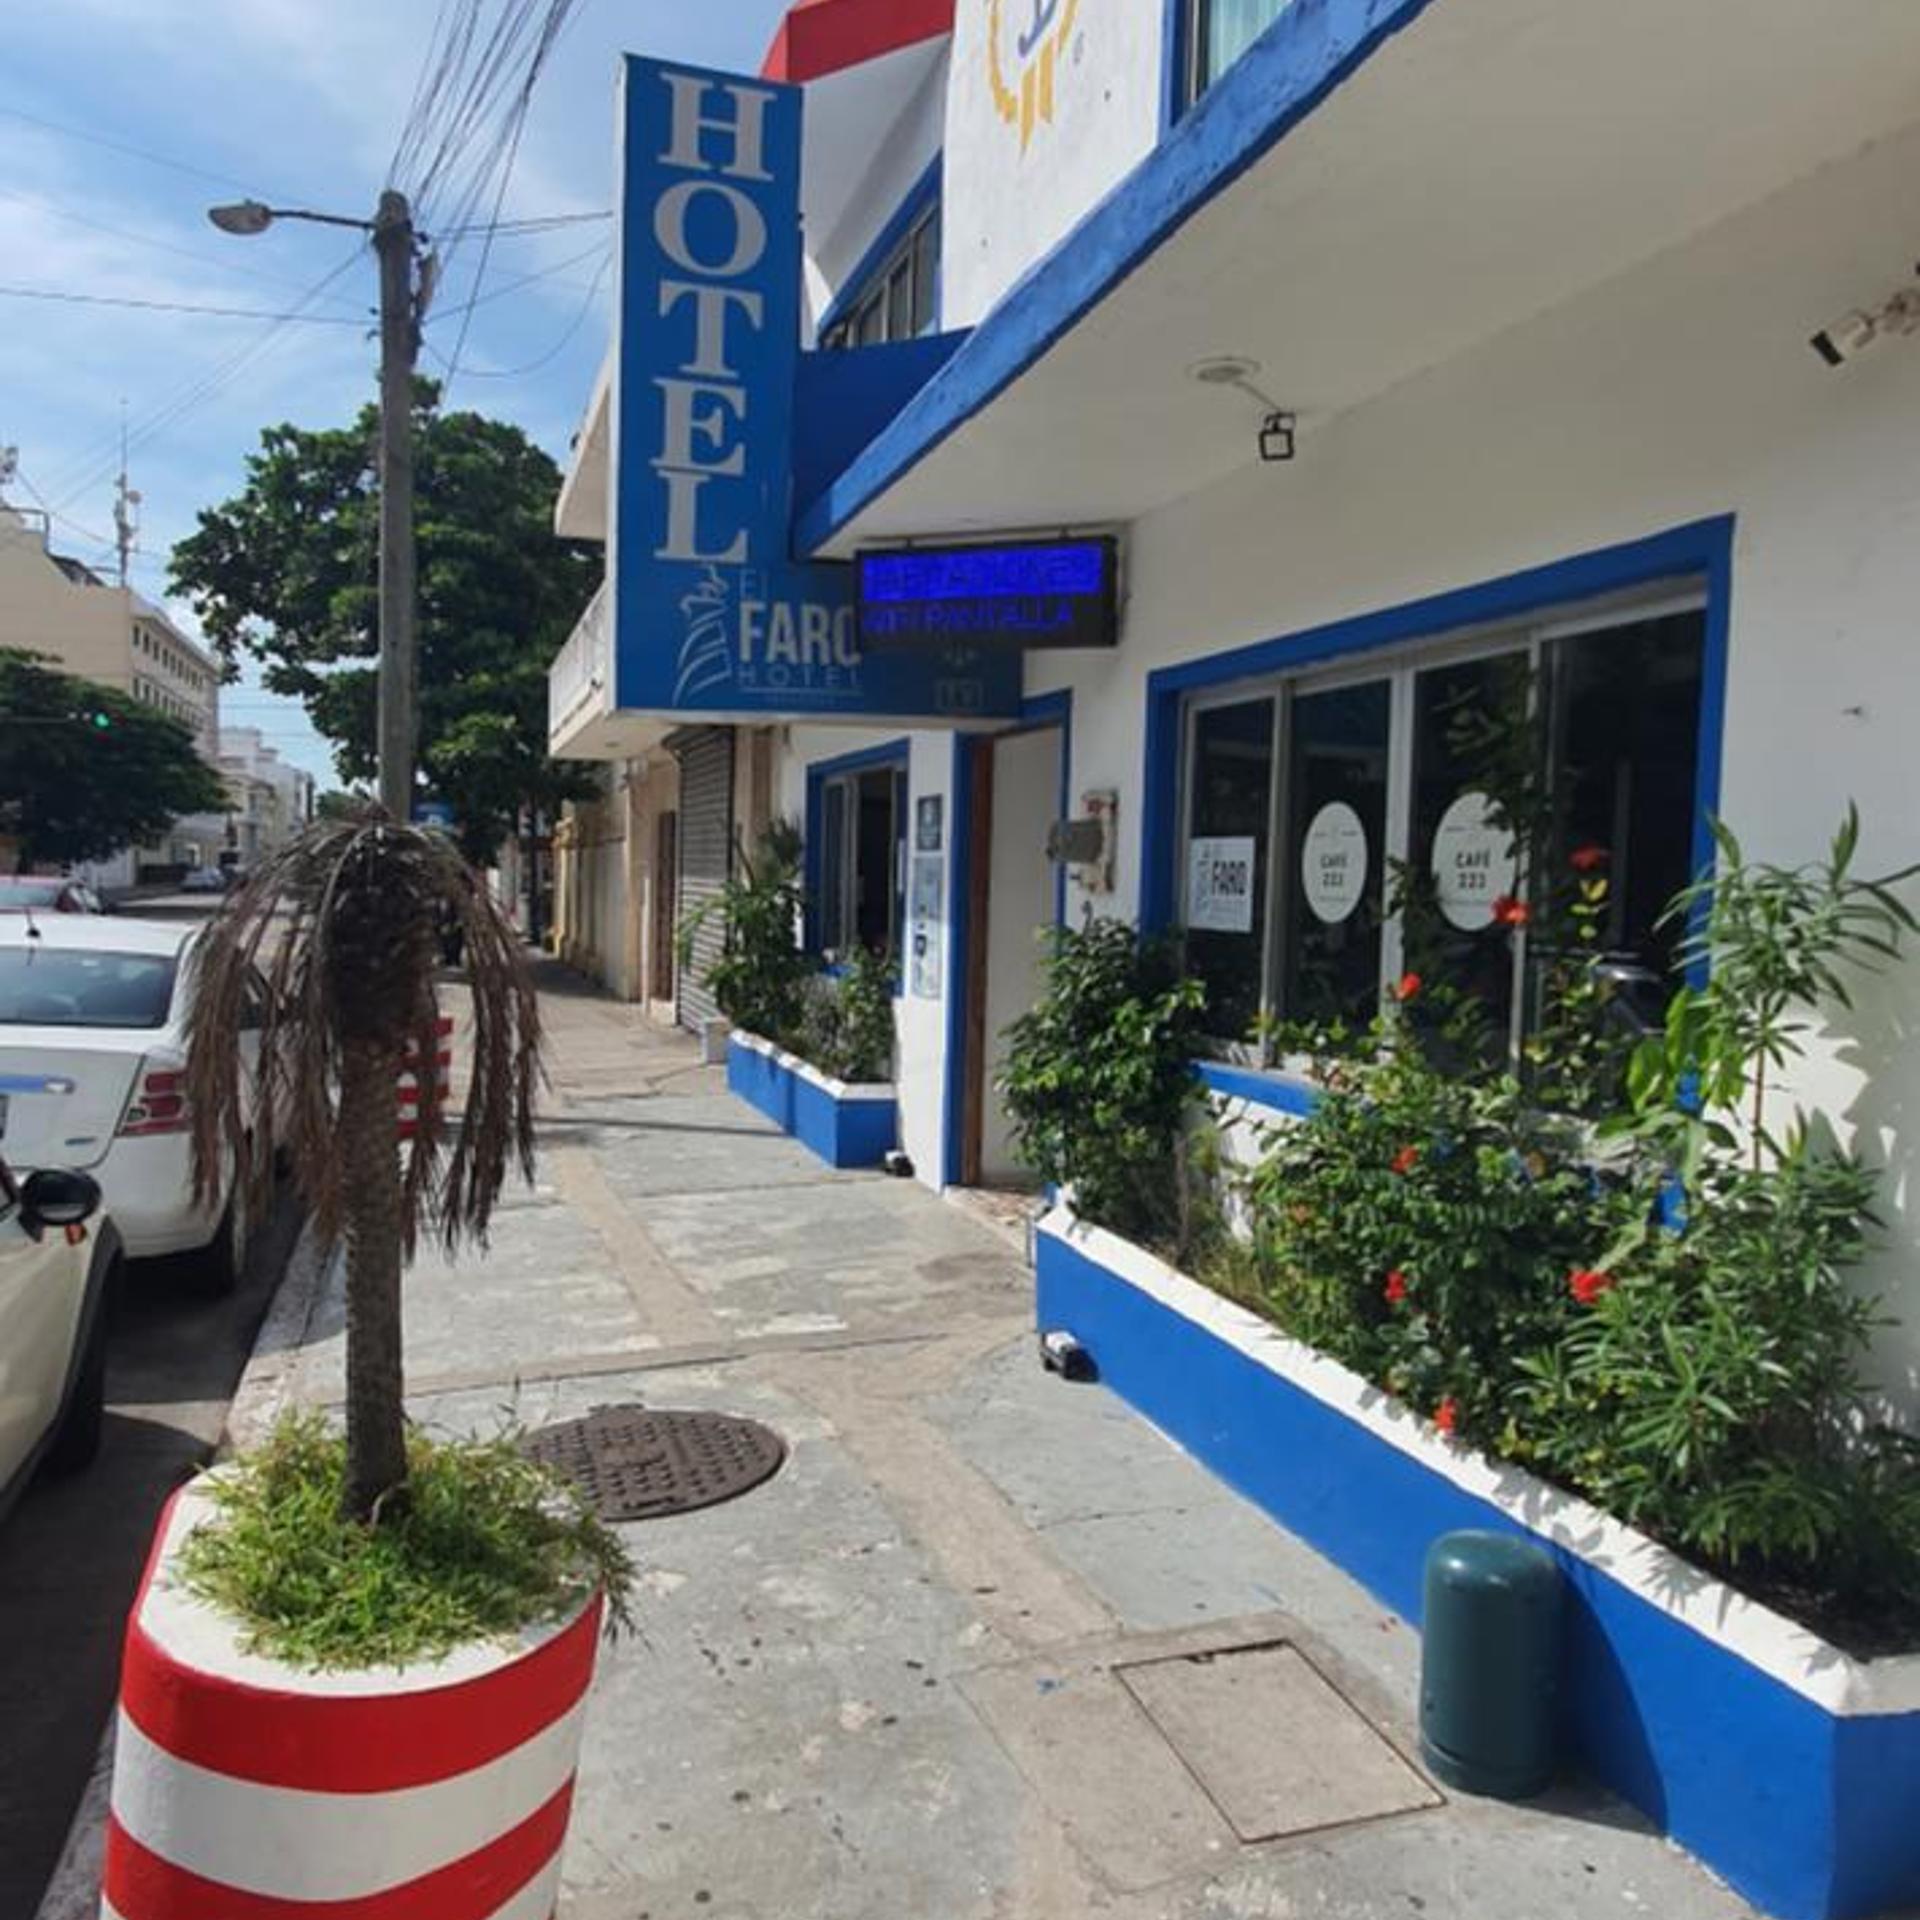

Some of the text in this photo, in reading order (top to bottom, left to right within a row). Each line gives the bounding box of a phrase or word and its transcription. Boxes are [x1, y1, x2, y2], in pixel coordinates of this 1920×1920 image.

[650, 71, 777, 563] HOTEL
[739, 600, 863, 667] FARO
[738, 663, 861, 688] HOTEL
[1456, 848, 1491, 869] CAFÉ
[1211, 860, 1249, 896] FARO
